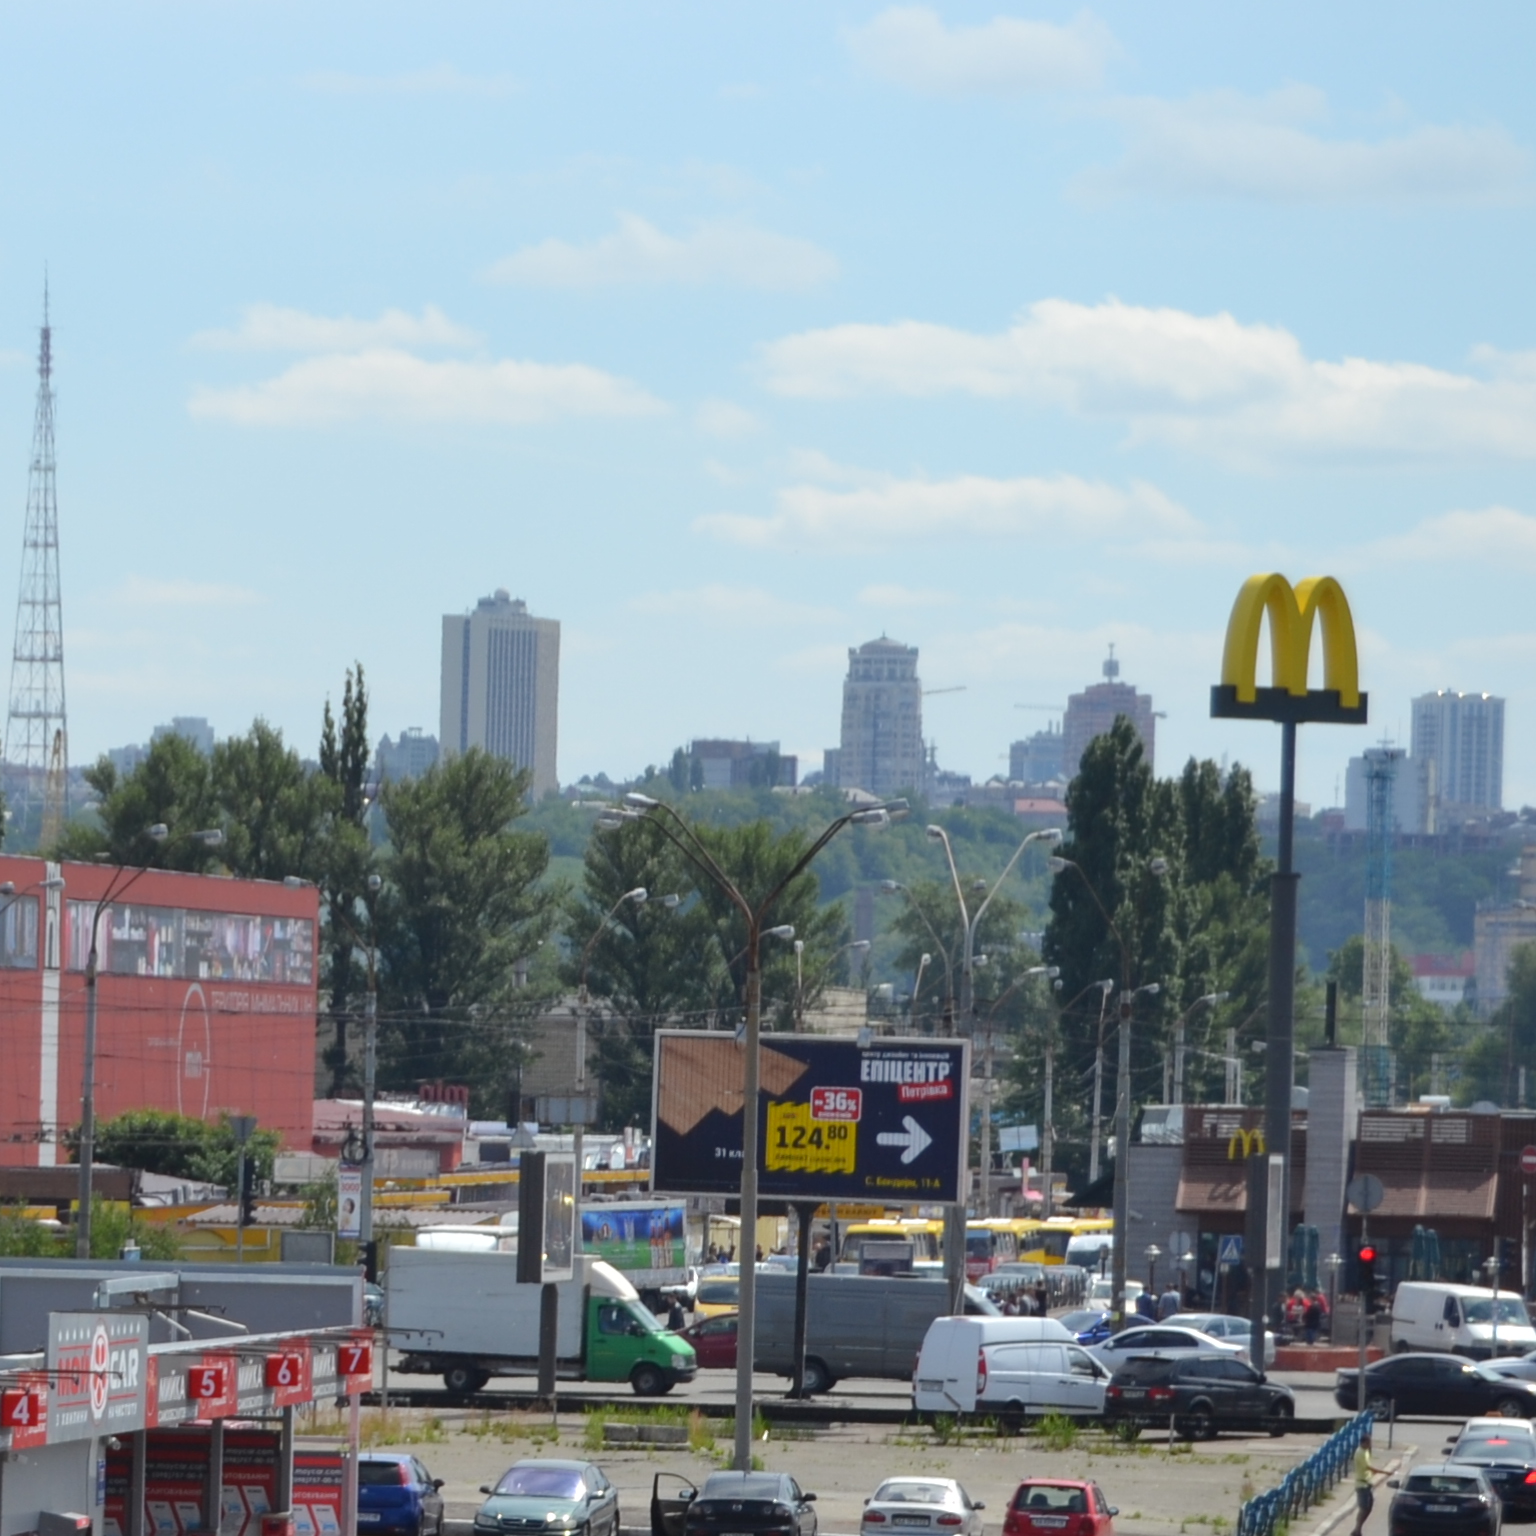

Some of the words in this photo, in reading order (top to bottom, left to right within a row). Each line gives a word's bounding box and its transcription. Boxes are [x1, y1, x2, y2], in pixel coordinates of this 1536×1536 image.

[860, 1059, 950, 1084] ЕПІЦЕНТР
[109, 1348, 139, 1391] CAR
[278, 1359, 291, 1385] 6
[348, 1348, 362, 1372] 7
[201, 1370, 216, 1397] 5
[11, 1395, 31, 1425] 4
